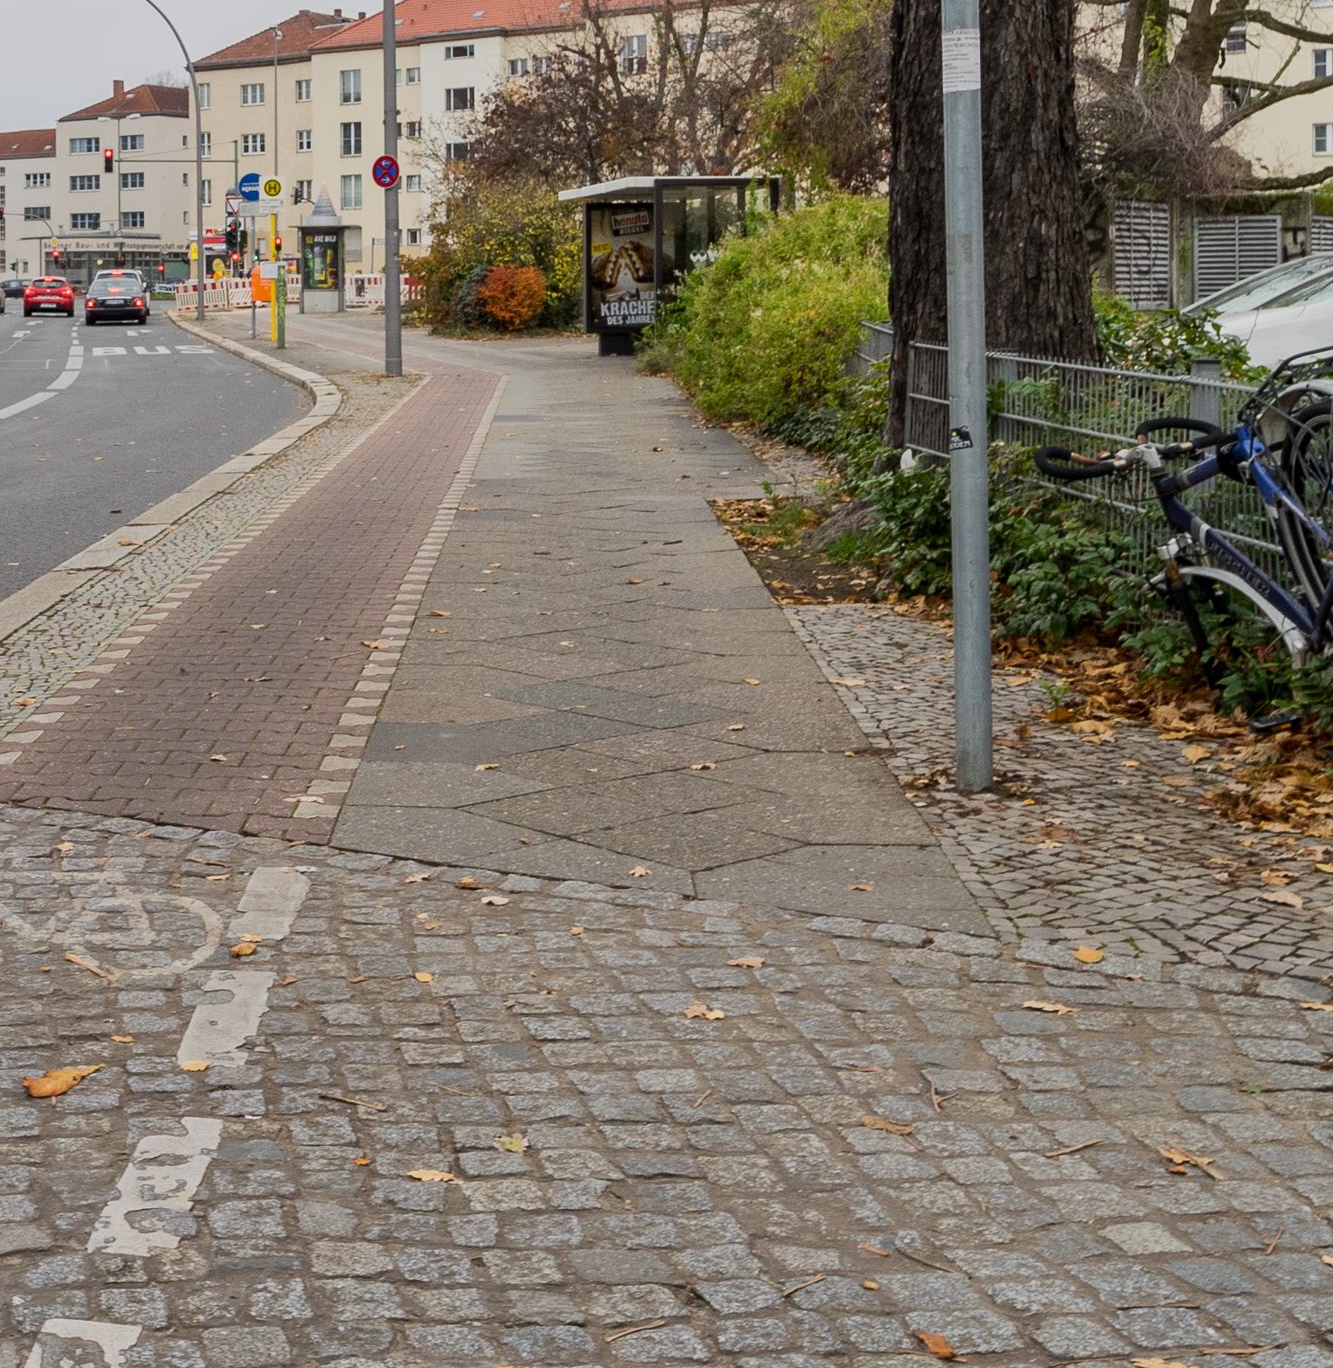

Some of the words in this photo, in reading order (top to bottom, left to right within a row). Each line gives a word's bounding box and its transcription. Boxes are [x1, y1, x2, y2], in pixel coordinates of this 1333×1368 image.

[268, 184, 277, 193] H
[614, 214, 647, 228] hanuta
[600, 300, 655, 317] KRACHE
[607, 316, 624, 326] DES
[91, 344, 217, 357] BUS
